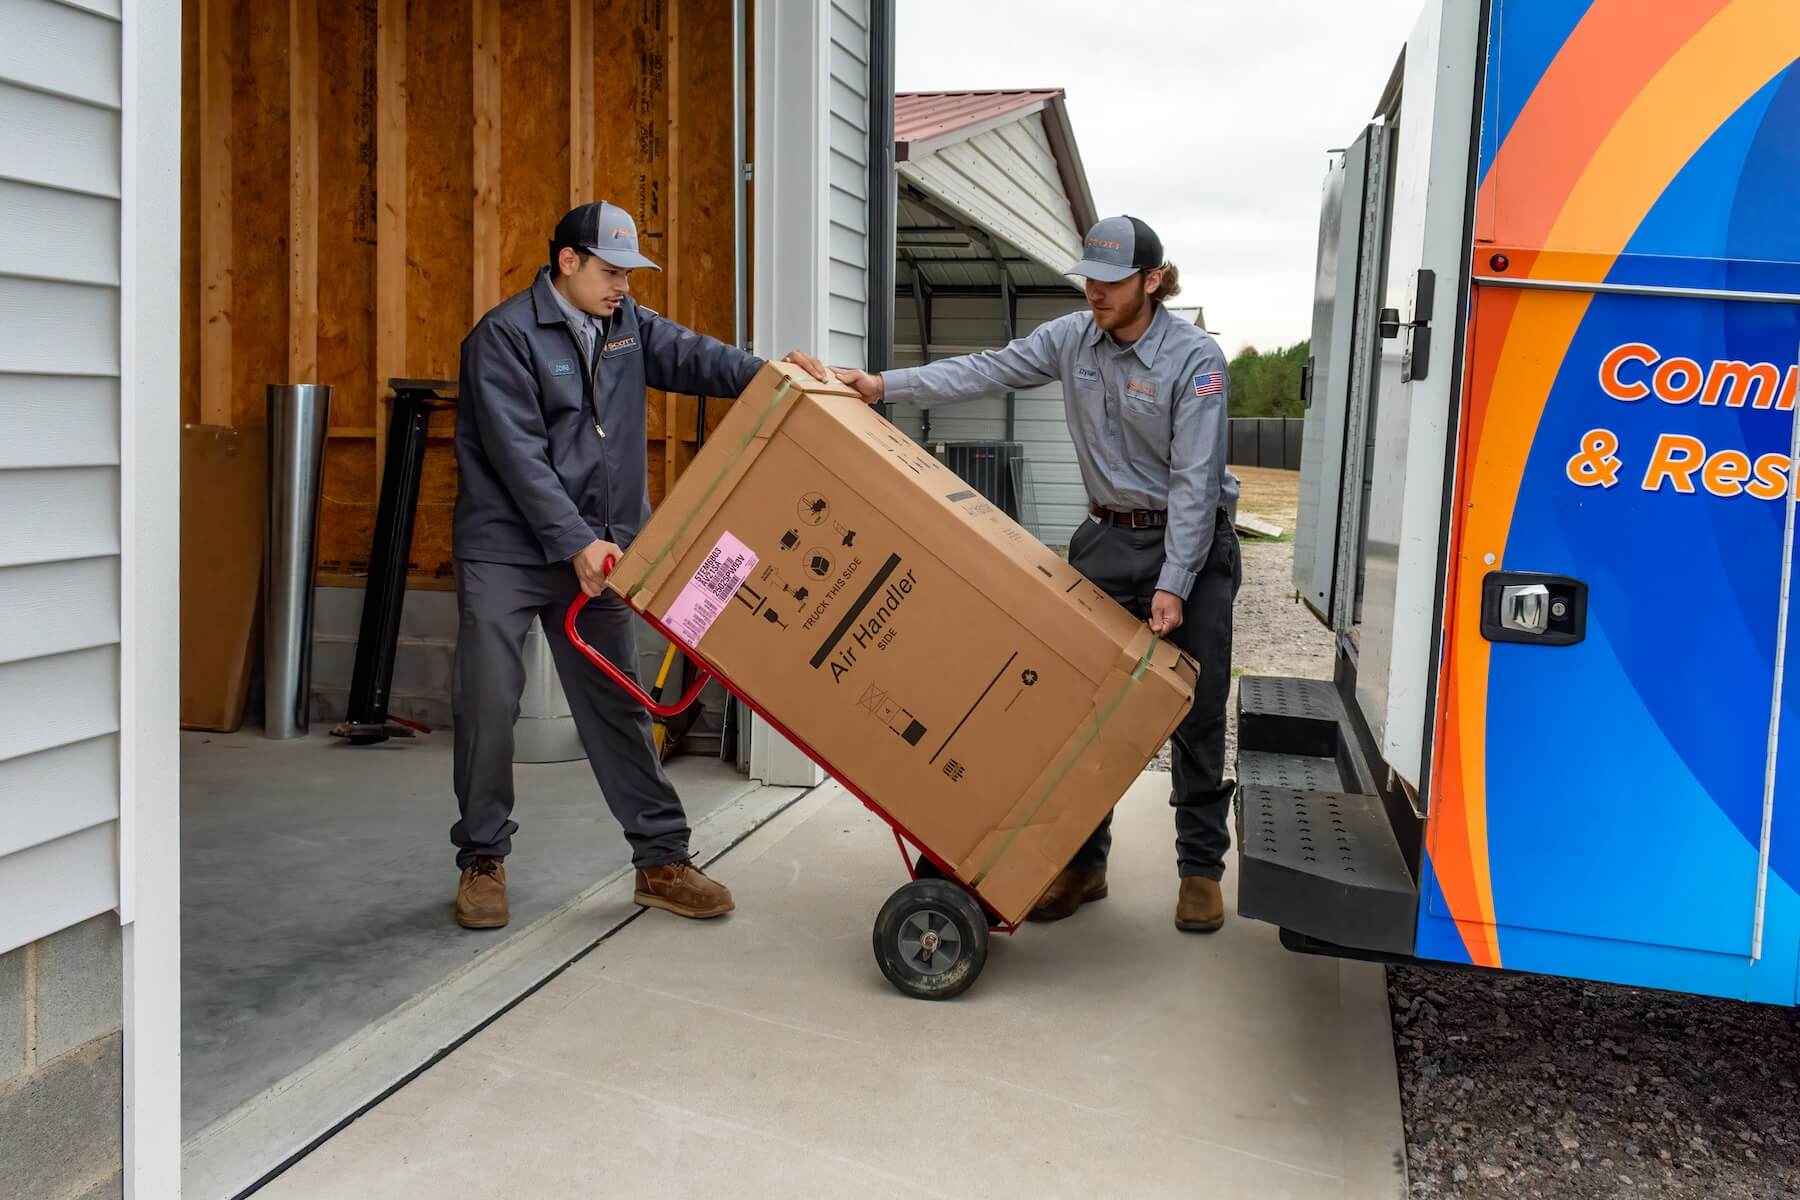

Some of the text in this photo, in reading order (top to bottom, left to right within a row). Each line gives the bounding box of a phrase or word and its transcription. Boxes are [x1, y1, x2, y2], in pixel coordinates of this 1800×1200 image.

[607, 337, 635, 348] SCOTT
[1566, 428, 1800, 501] & Res
[802, 600, 830, 631] TRUCK
[825, 578, 846, 601] THIS
[843, 556, 863, 583] SIDE
[830, 568, 917, 684] Air Handler
[877, 627, 898, 651] SIDE
